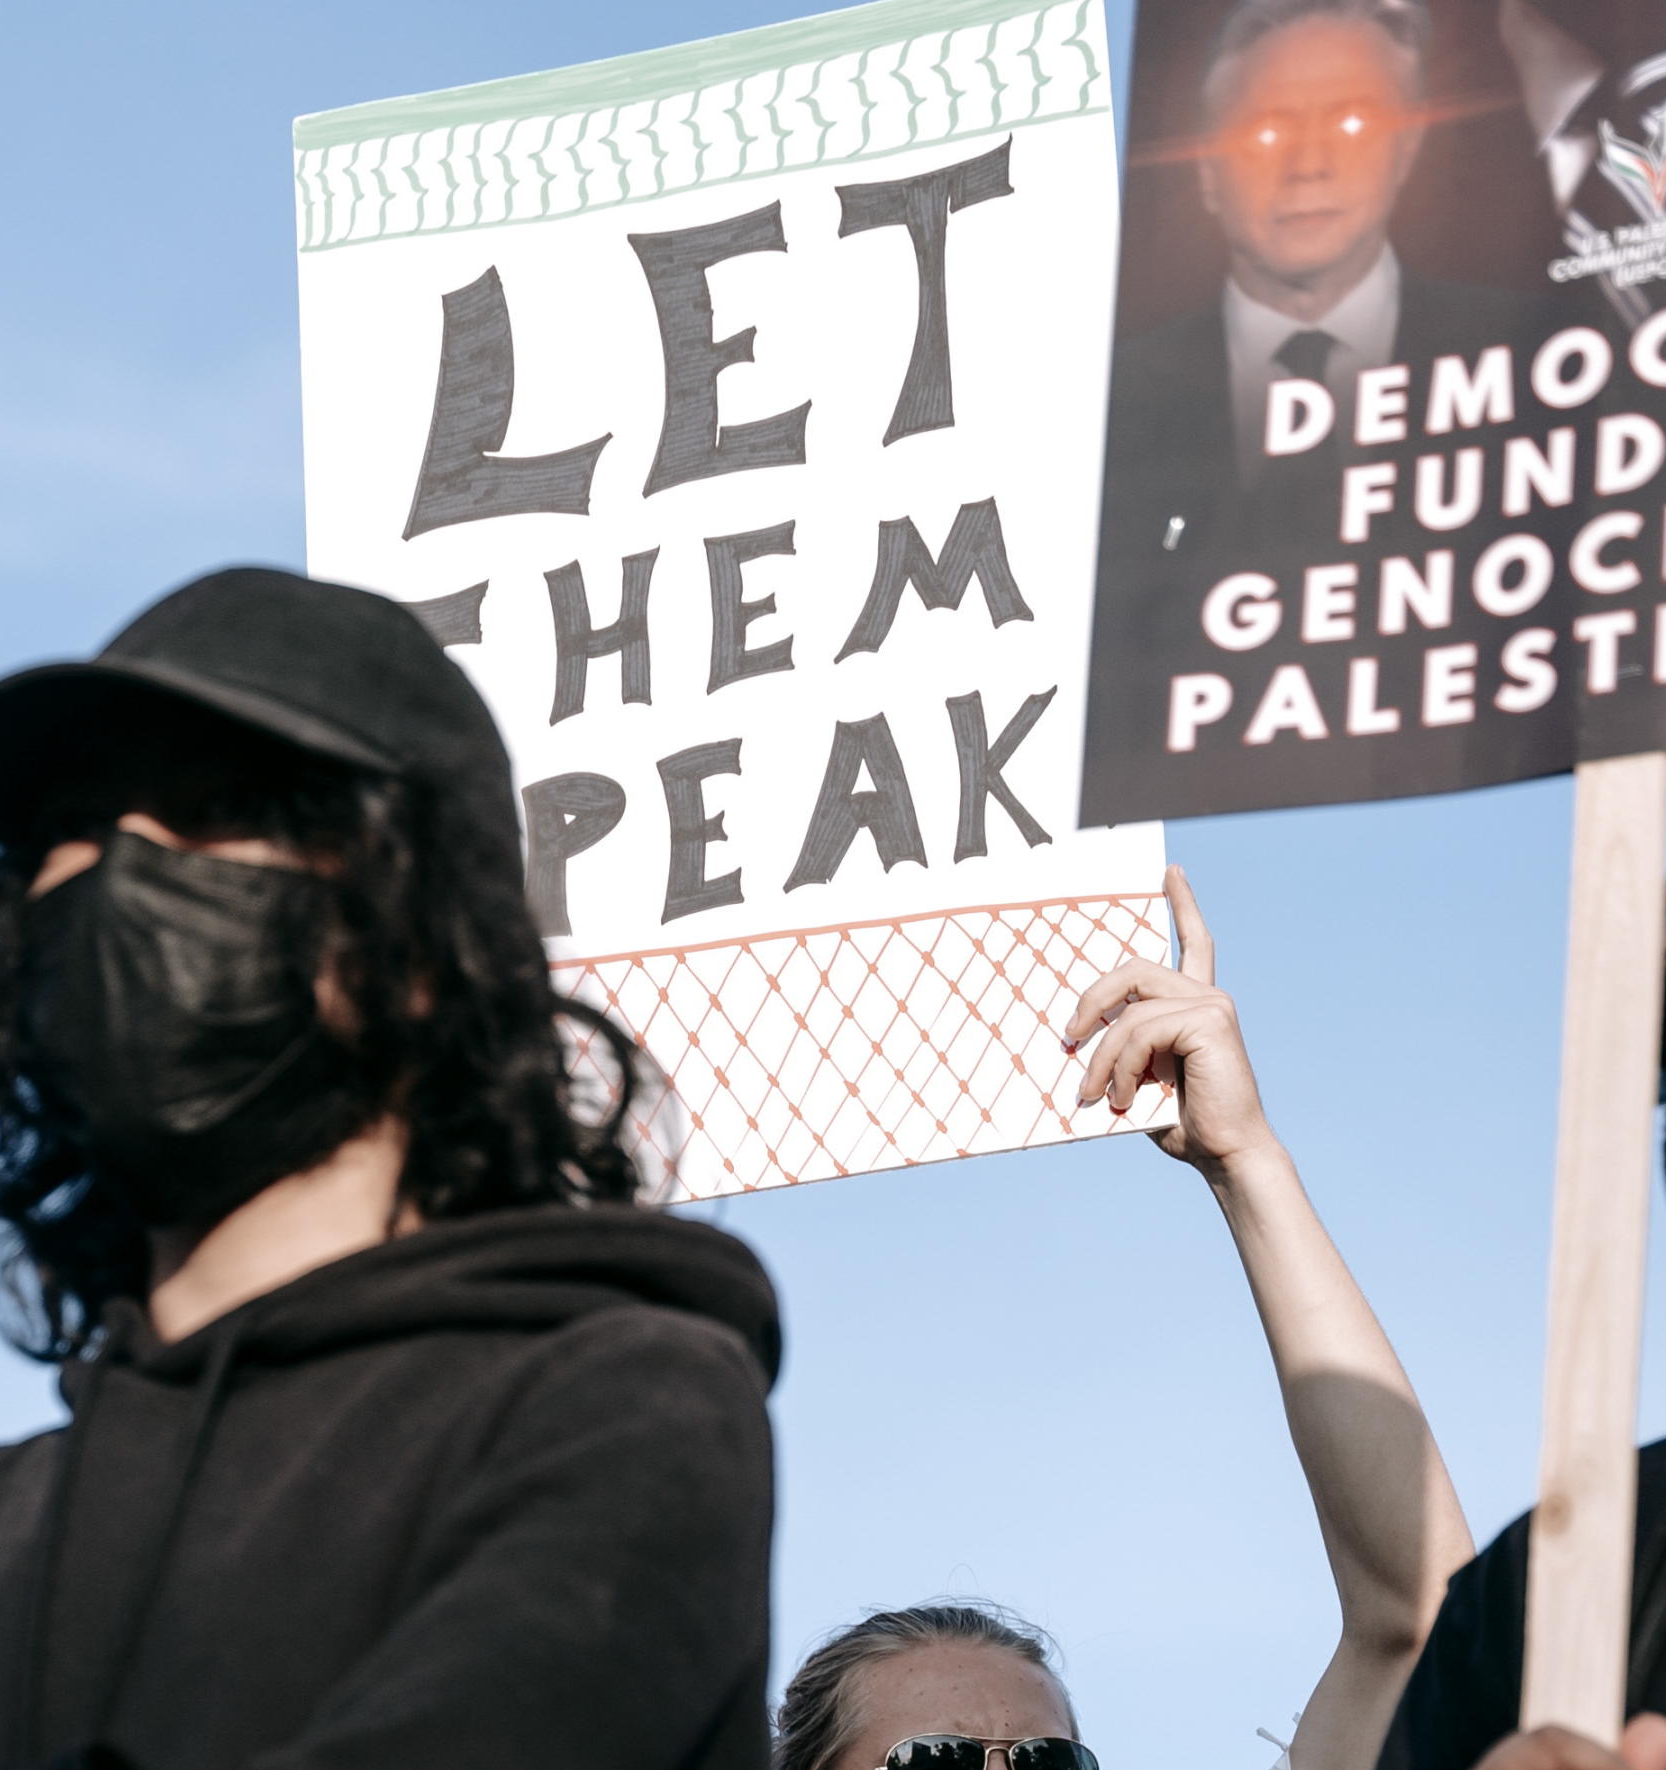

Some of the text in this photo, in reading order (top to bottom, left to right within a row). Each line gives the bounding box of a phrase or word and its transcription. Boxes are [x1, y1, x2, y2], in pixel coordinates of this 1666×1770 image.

[400, 131, 1016, 543] LET
[1340, 412, 1666, 544] FUND
[403, 495, 1036, 729] HEM
[520, 684, 1058, 938] PEAK
